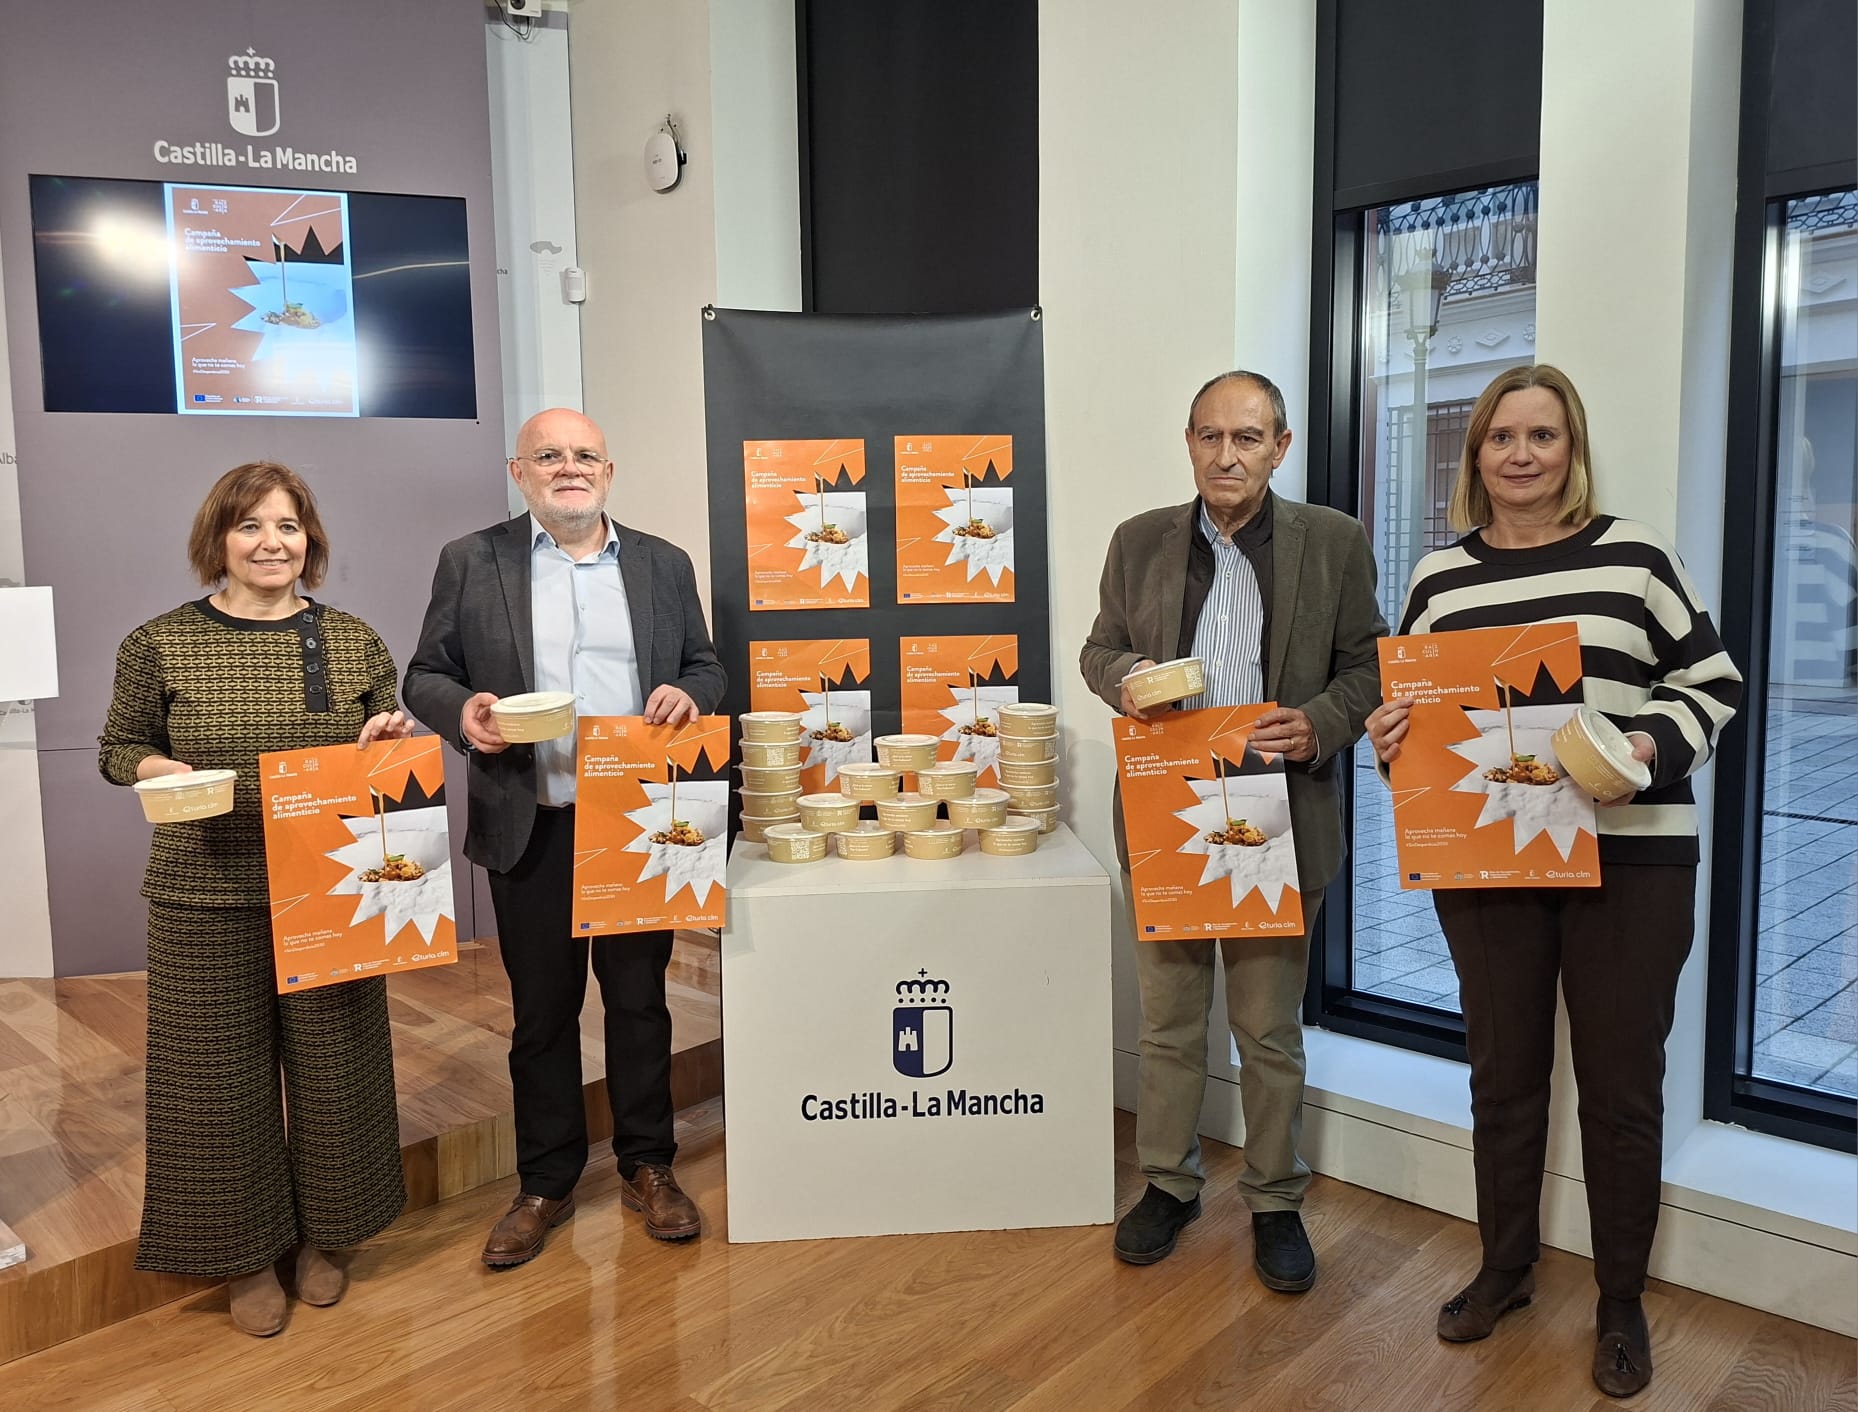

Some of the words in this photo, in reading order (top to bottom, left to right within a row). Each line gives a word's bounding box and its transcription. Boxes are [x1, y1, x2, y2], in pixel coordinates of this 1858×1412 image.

[153, 140, 273, 168] Castilla-La
[276, 147, 357, 173] Mancha
[1390, 678, 1433, 690] Campaña
[1391, 690, 1402, 698] de
[1404, 684, 1480, 697] aprovechamiento
[584, 754, 619, 764] Campaña
[1124, 752, 1160, 763] Campaña
[594, 762, 656, 772] aprovechamiento
[1136, 758, 1200, 770] aprovechamiento
[1126, 768, 1168, 778] alimenticio
[271, 792, 313, 803] Campaña
[272, 804, 283, 812] de
[284, 796, 357, 812] aprovechamiento
[272, 807, 320, 820] alimenticio
[800, 1090, 941, 1121] Castilla-La
[946, 1088, 1045, 1117] Mancha
